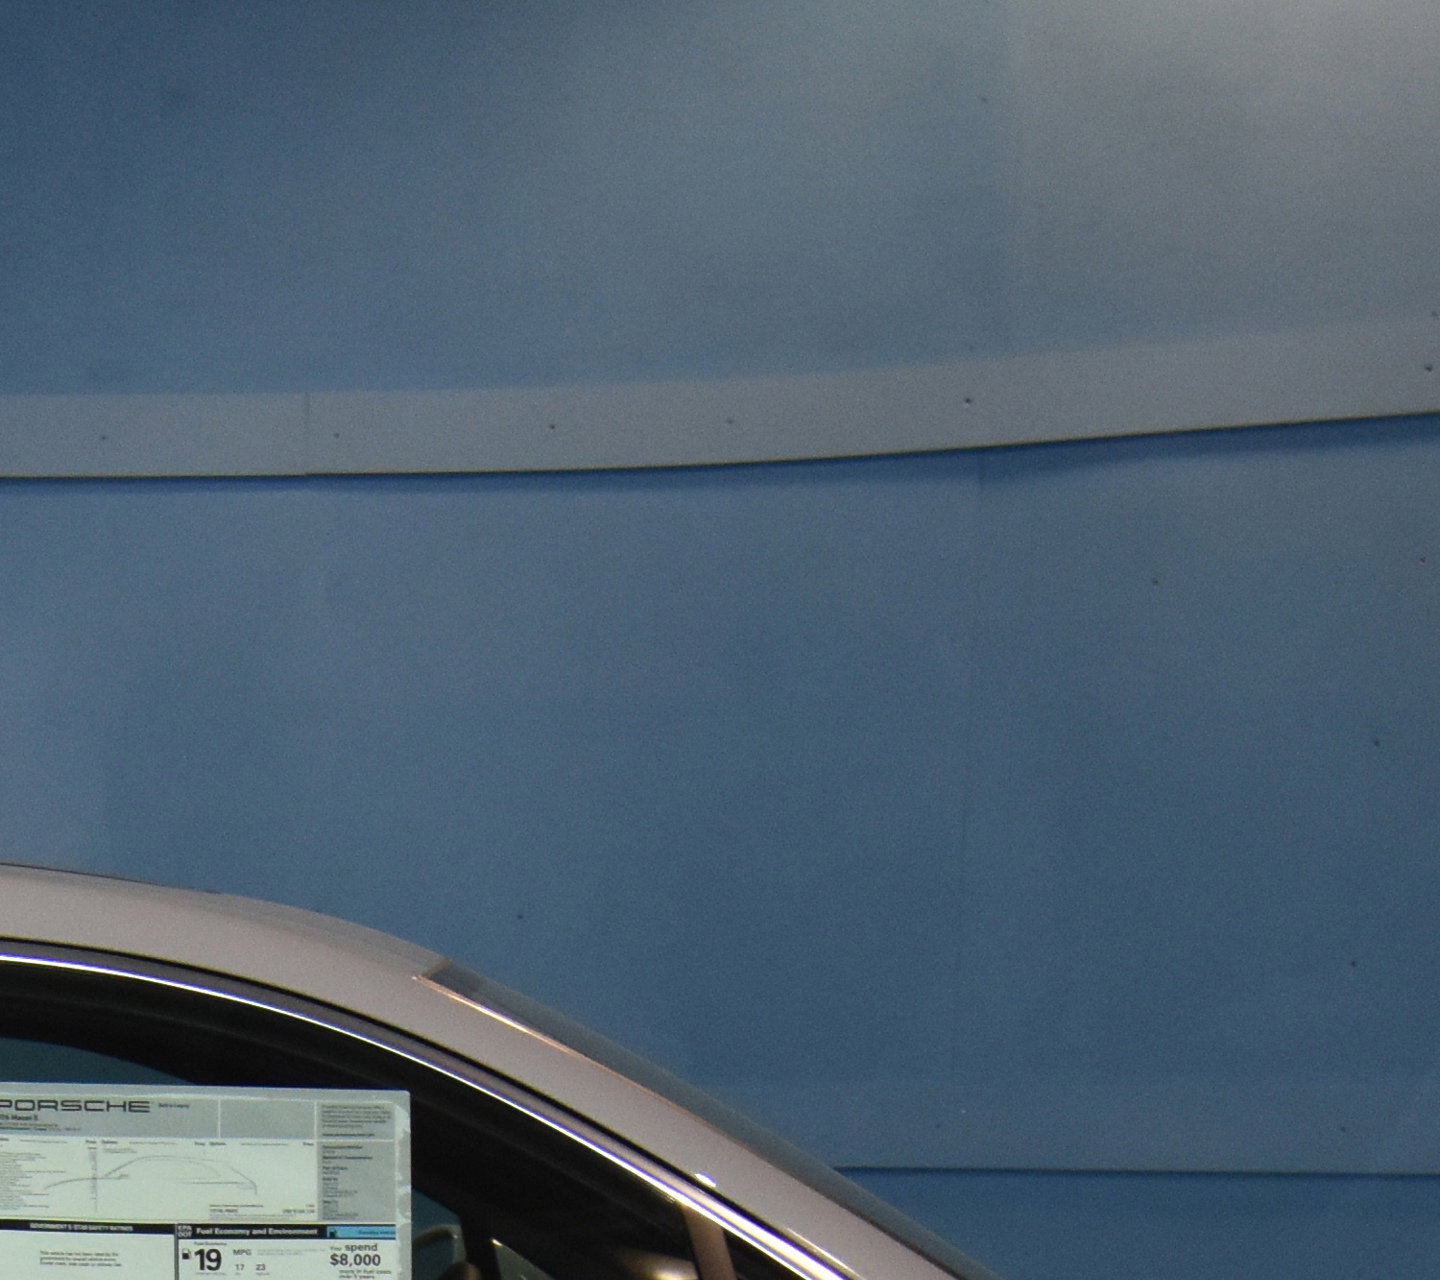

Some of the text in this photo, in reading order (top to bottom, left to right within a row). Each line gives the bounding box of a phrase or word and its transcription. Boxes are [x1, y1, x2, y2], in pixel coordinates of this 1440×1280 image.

[196, 1227, 213, 1235] Fuel
[215, 1228, 250, 1237] Economy
[269, 1228, 318, 1236] Environment
[345, 1243, 378, 1252] spend
[194, 1249, 222, 1271] 19
[330, 1253, 381, 1267] $8,000
[235, 1263, 245, 1271] 17
[255, 1263, 266, 1271] 23
